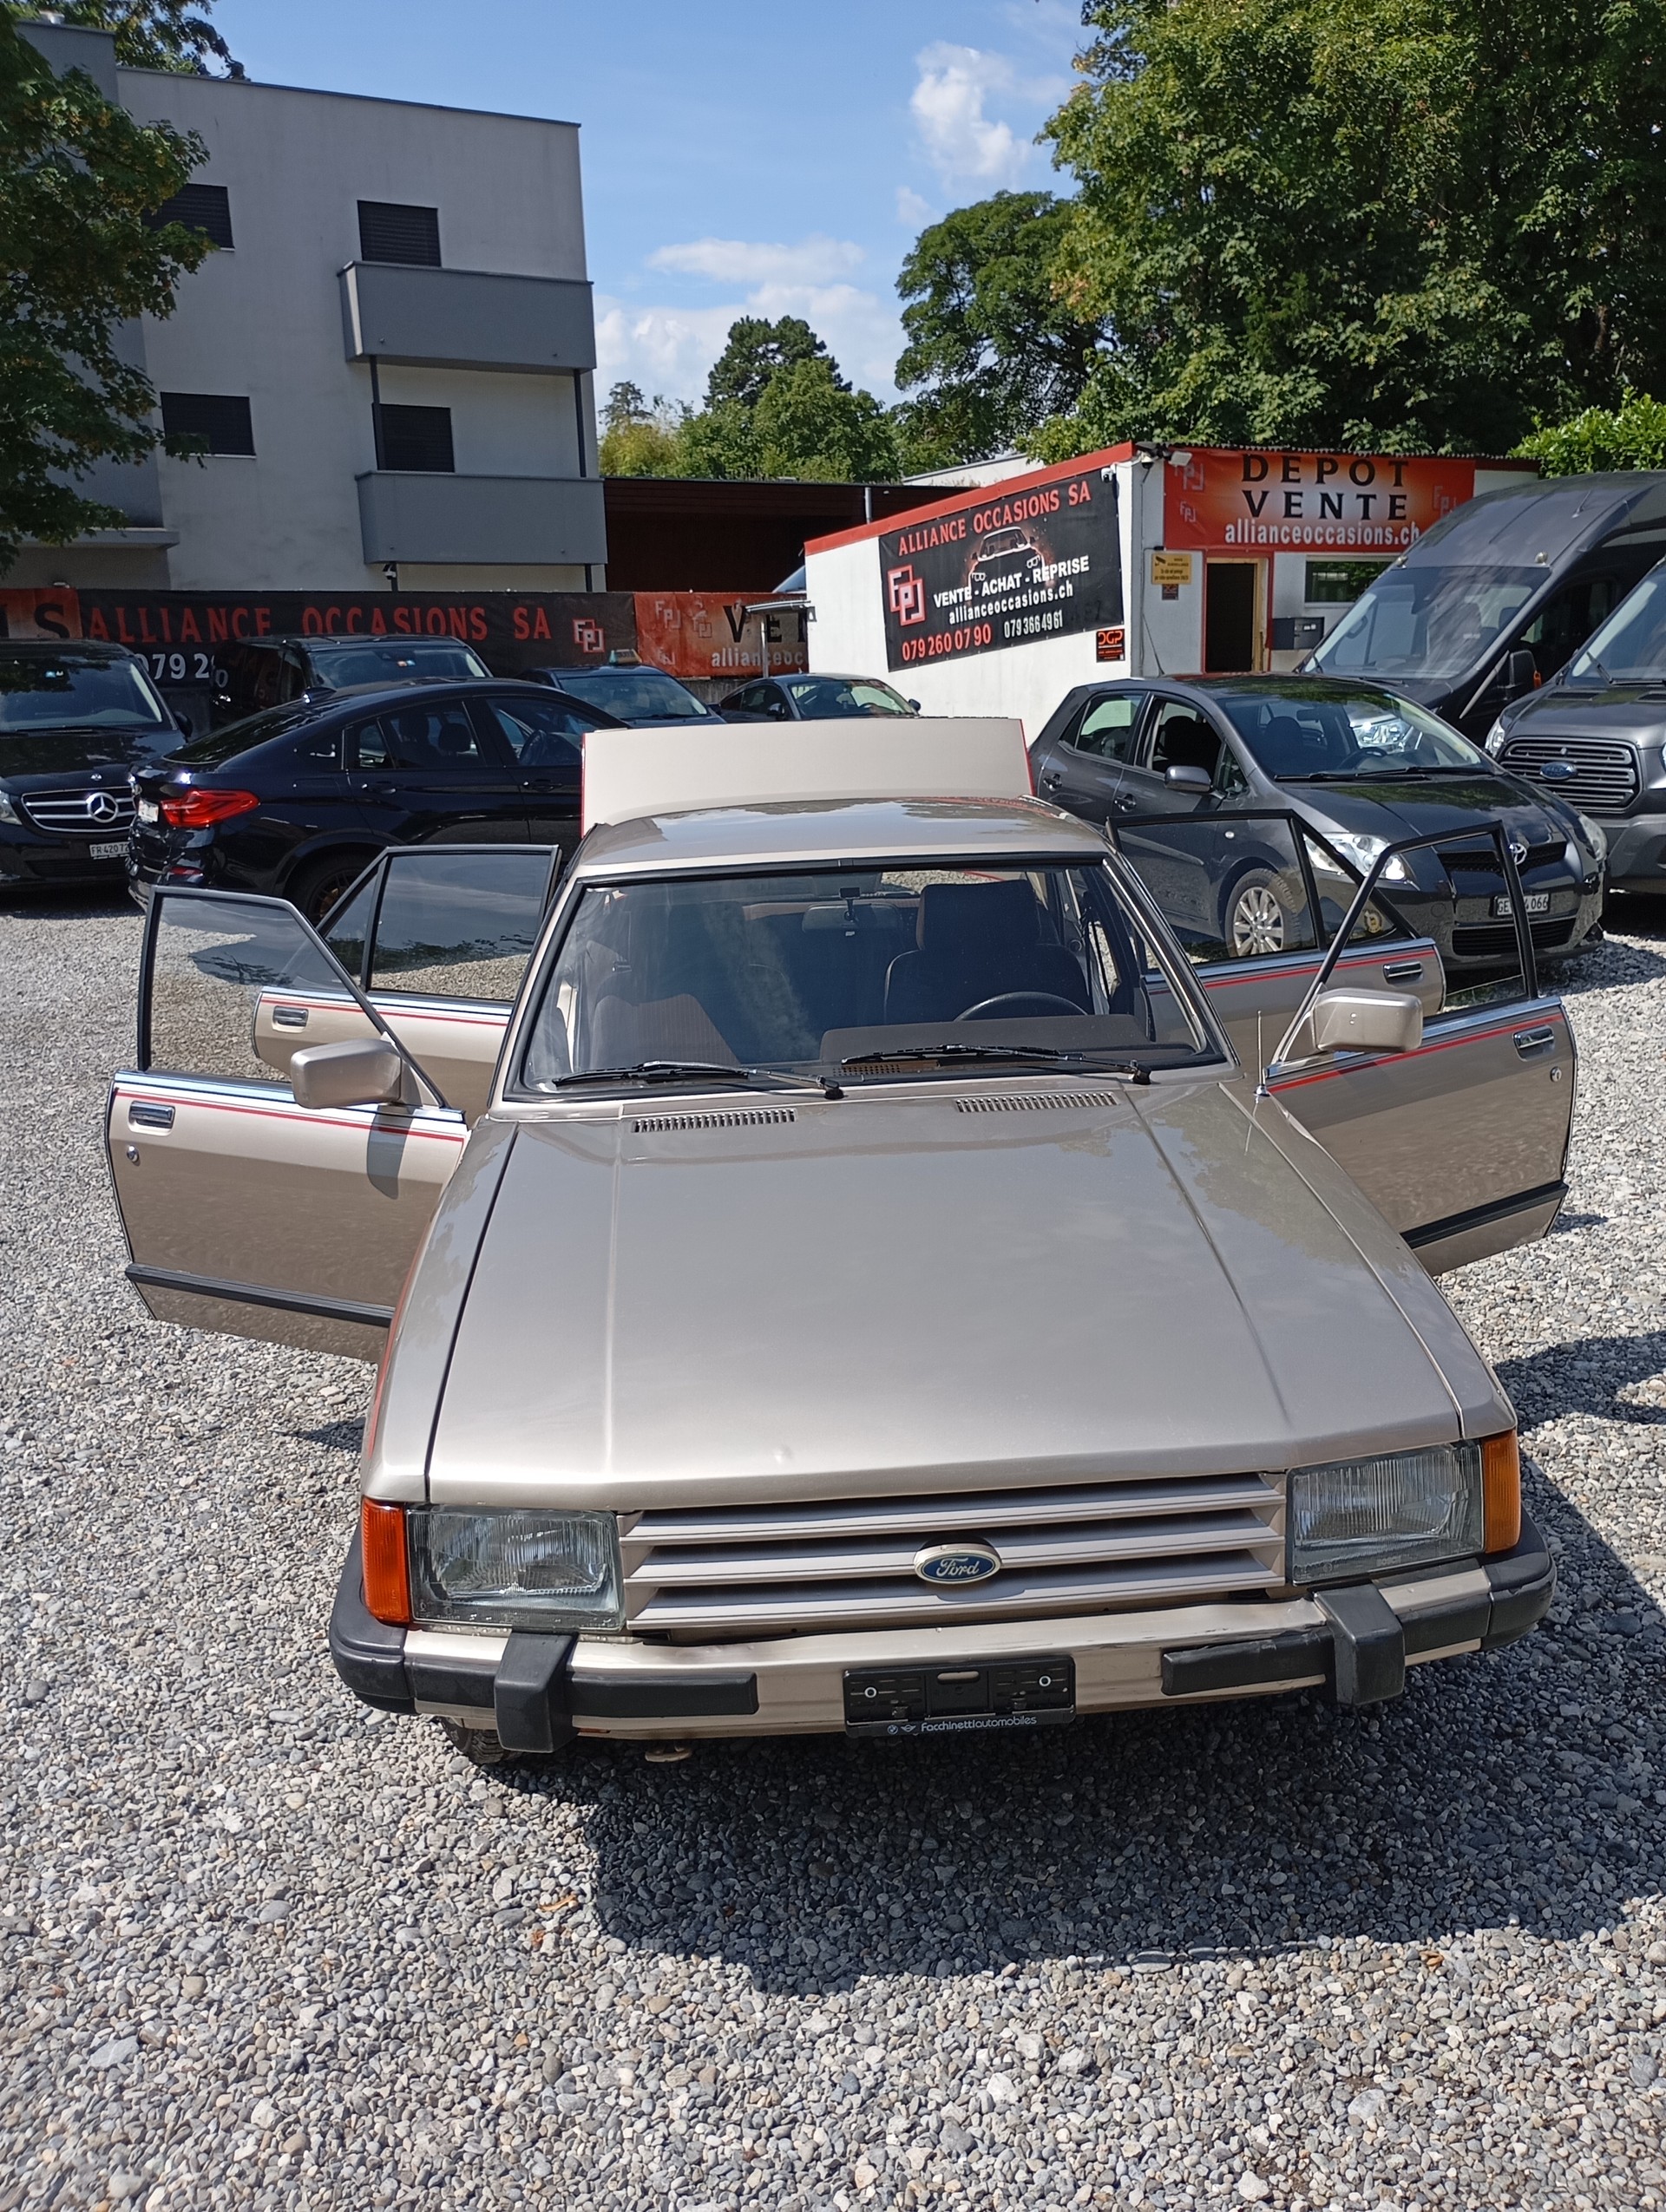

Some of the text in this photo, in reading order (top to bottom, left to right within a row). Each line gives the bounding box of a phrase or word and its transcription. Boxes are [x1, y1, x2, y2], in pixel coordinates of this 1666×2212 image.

[898, 481, 1092, 557] ALLIANCE OCCASIONS SA
[1242, 489, 1407, 520] VENTE
[1224, 518, 1420, 546] allianceoccasions.ch
[933, 586, 973, 609] VENTE
[981, 573, 1023, 598] ACHAT
[1033, 555, 1091, 584] REPRISE
[948, 579, 1073, 625] allianceoccasions.ch
[89, 606, 553, 643] ALLIANCE OCCASIONS SA
[1004, 608, 1063, 638] 079 366 49 61
[902, 622, 992, 662] 079 260 07 90
[1499, 900, 1510, 913] GE
[935, 1558, 980, 1577] Ford
